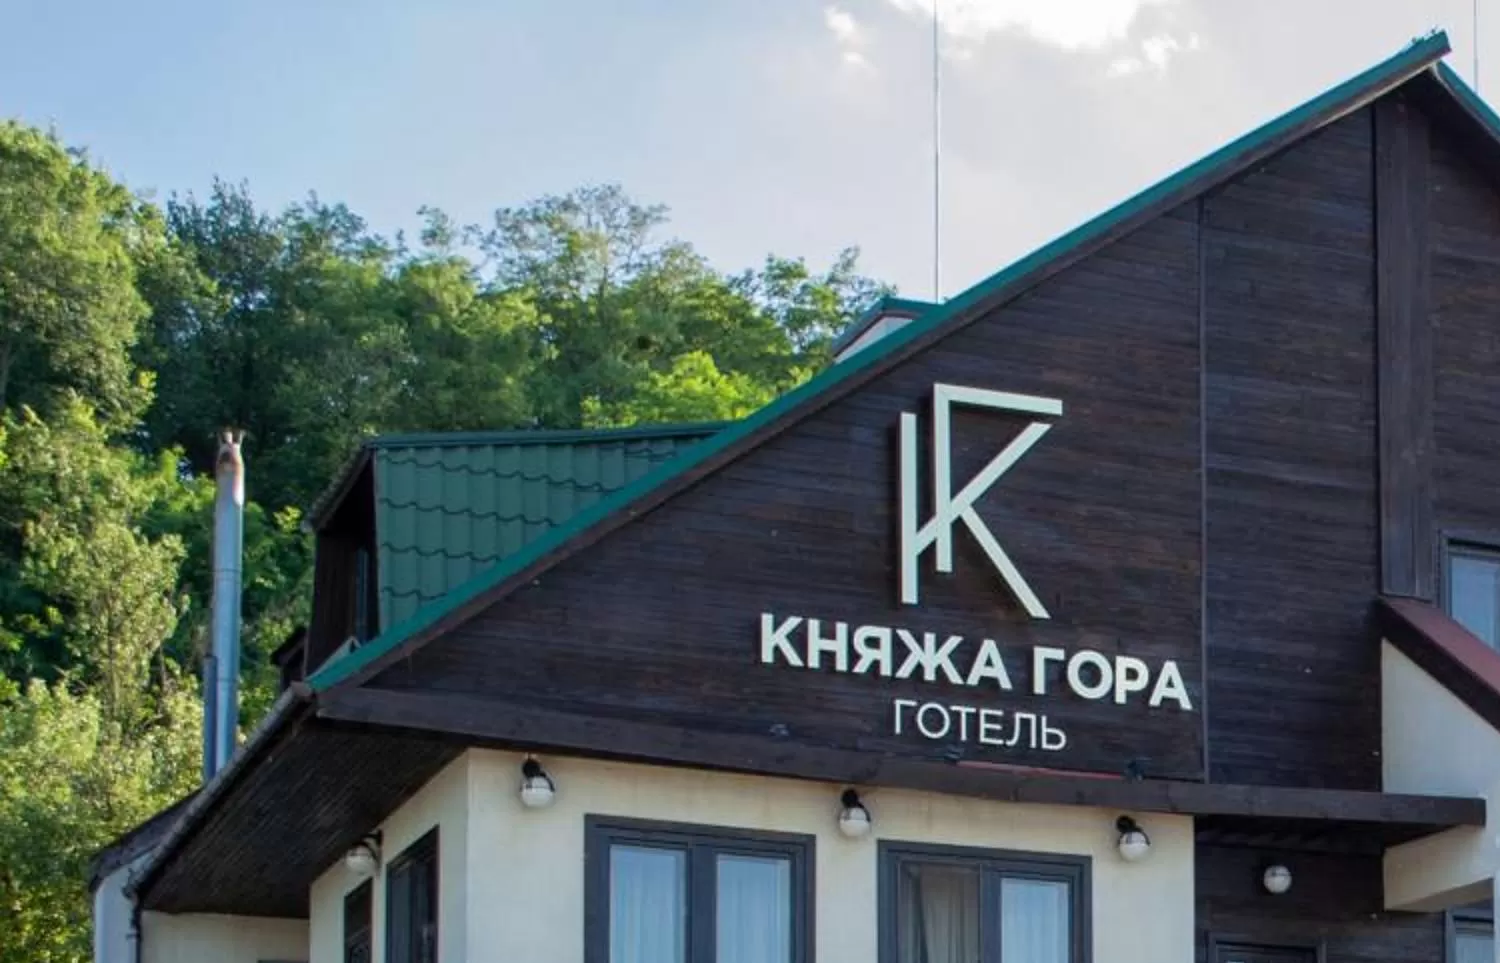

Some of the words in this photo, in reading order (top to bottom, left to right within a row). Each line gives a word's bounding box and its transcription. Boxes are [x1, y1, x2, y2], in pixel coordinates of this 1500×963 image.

[760, 613, 1012, 690] КНЯЖА
[1033, 646, 1193, 710] ГОРА
[894, 699, 1067, 750] ГОТЕЛЬ
